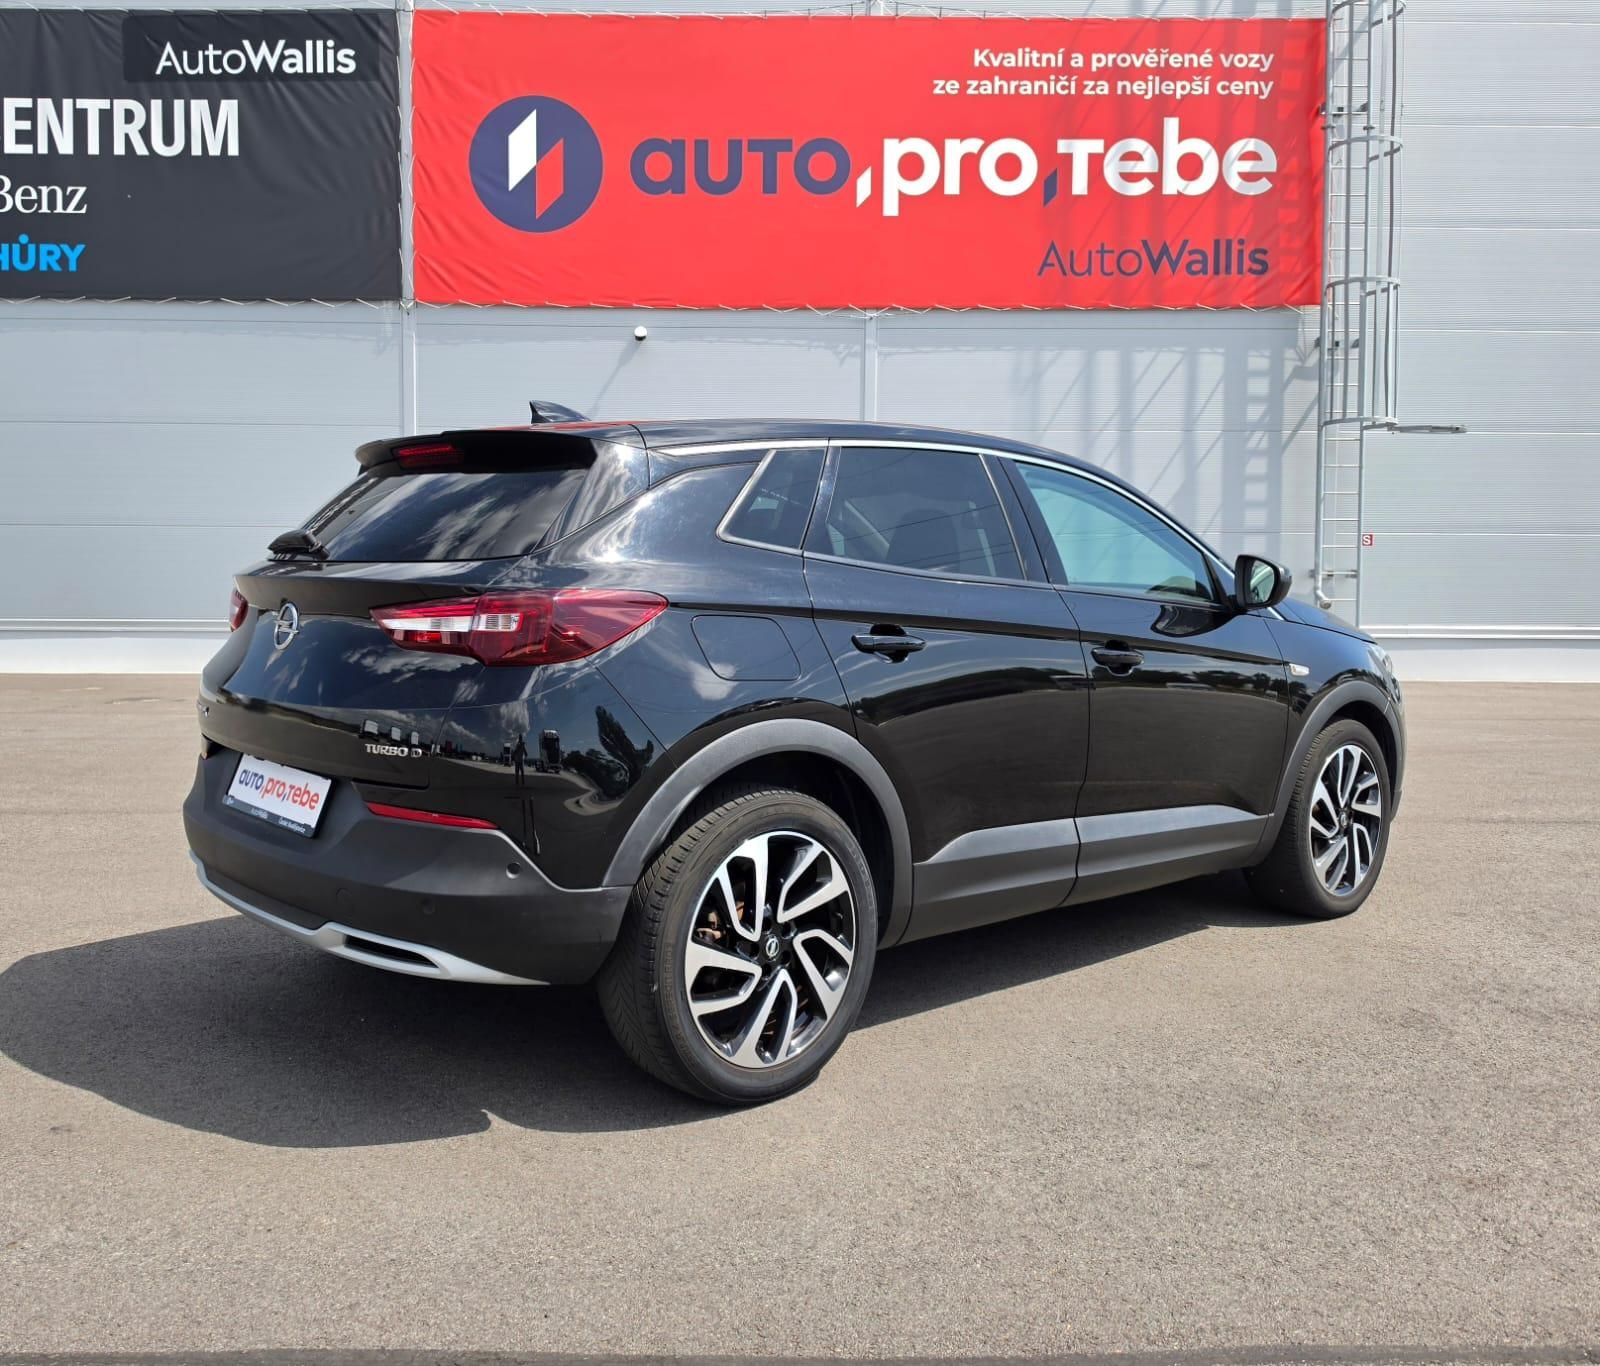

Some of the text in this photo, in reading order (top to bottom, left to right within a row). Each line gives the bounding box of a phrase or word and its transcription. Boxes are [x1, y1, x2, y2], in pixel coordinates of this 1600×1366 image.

[155, 39, 357, 75] AutoWallis
[973, 48, 1275, 72] Kvalitní a prověřené vozy
[933, 75, 1275, 99] ze zahraničí za nejlepší ceny
[1037, 239, 1269, 277] AutoWallis
[1362, 534, 1372, 546] S
[365, 743, 409, 757] TURBO
